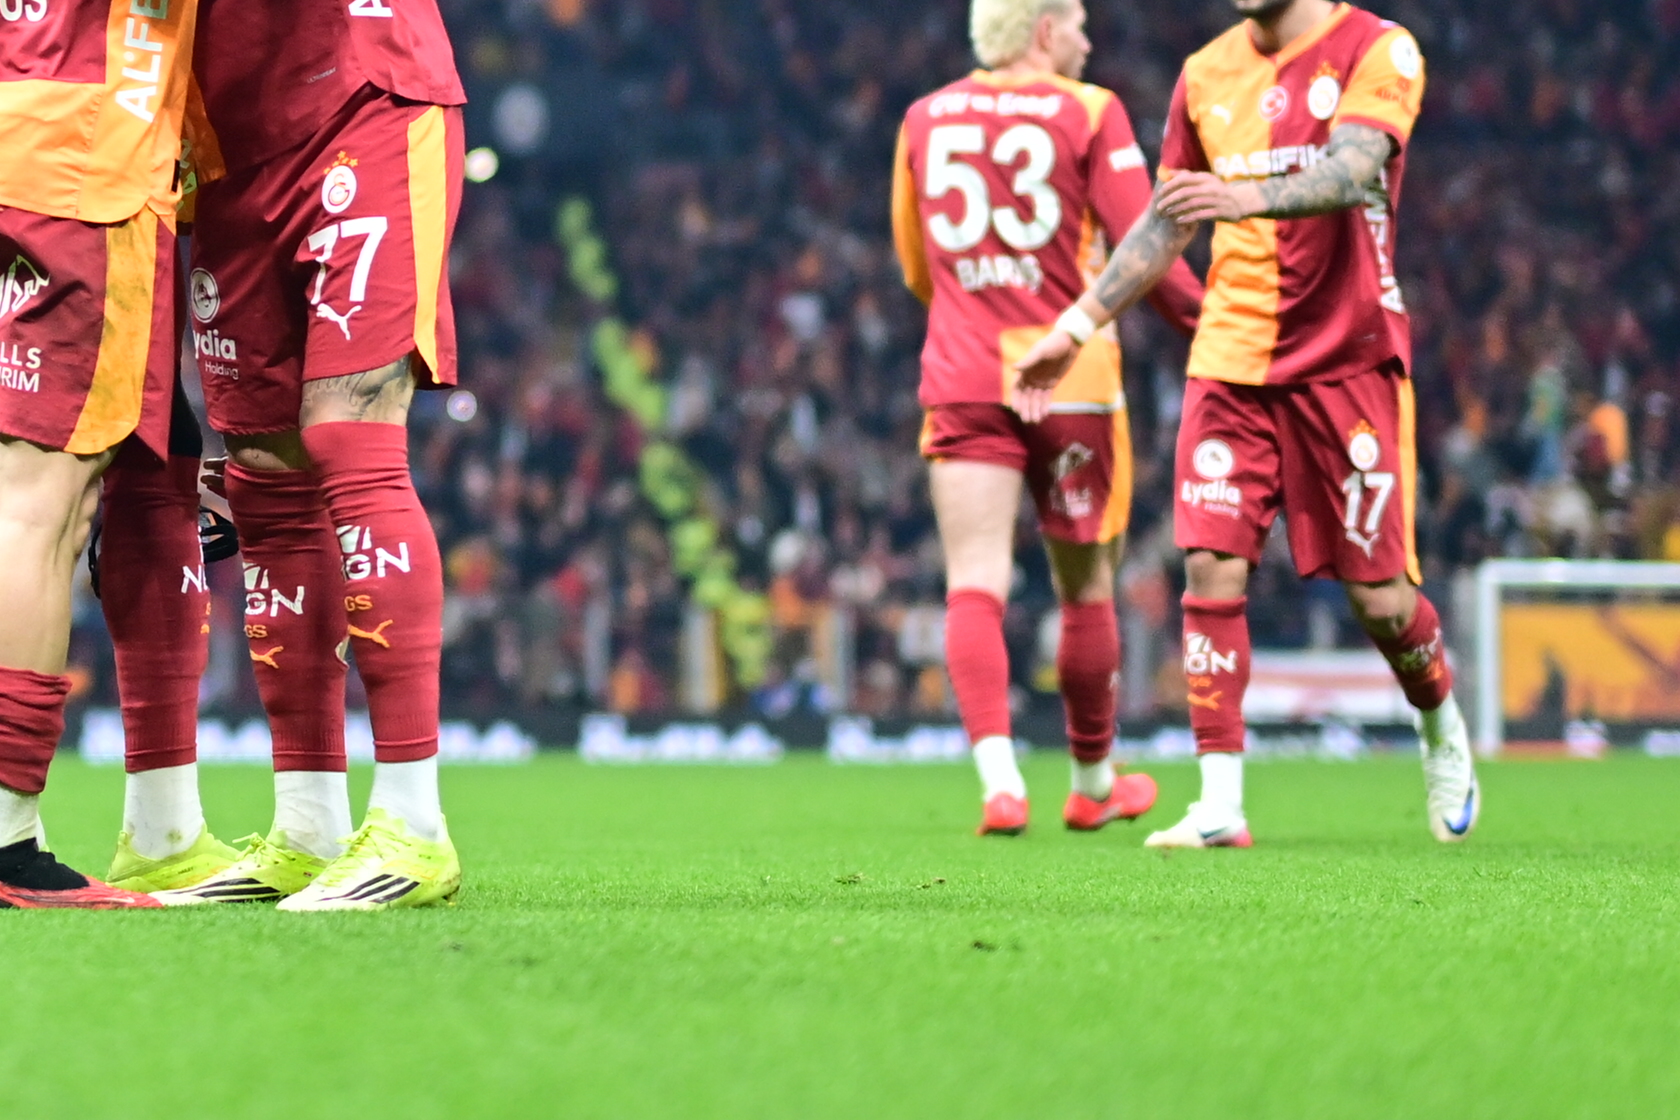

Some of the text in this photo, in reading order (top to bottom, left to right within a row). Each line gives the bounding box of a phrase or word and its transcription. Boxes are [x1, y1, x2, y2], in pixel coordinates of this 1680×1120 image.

[925, 125, 1062, 253] 53
[307, 216, 389, 305] 77
[192, 328, 238, 361] ydia
[204, 360, 239, 381] Holding
[1181, 480, 1243, 508] Lydia
[1342, 471, 1395, 534] 17
[341, 542, 411, 581] GN
[245, 586, 305, 617] GN
[344, 594, 373, 612] GS
